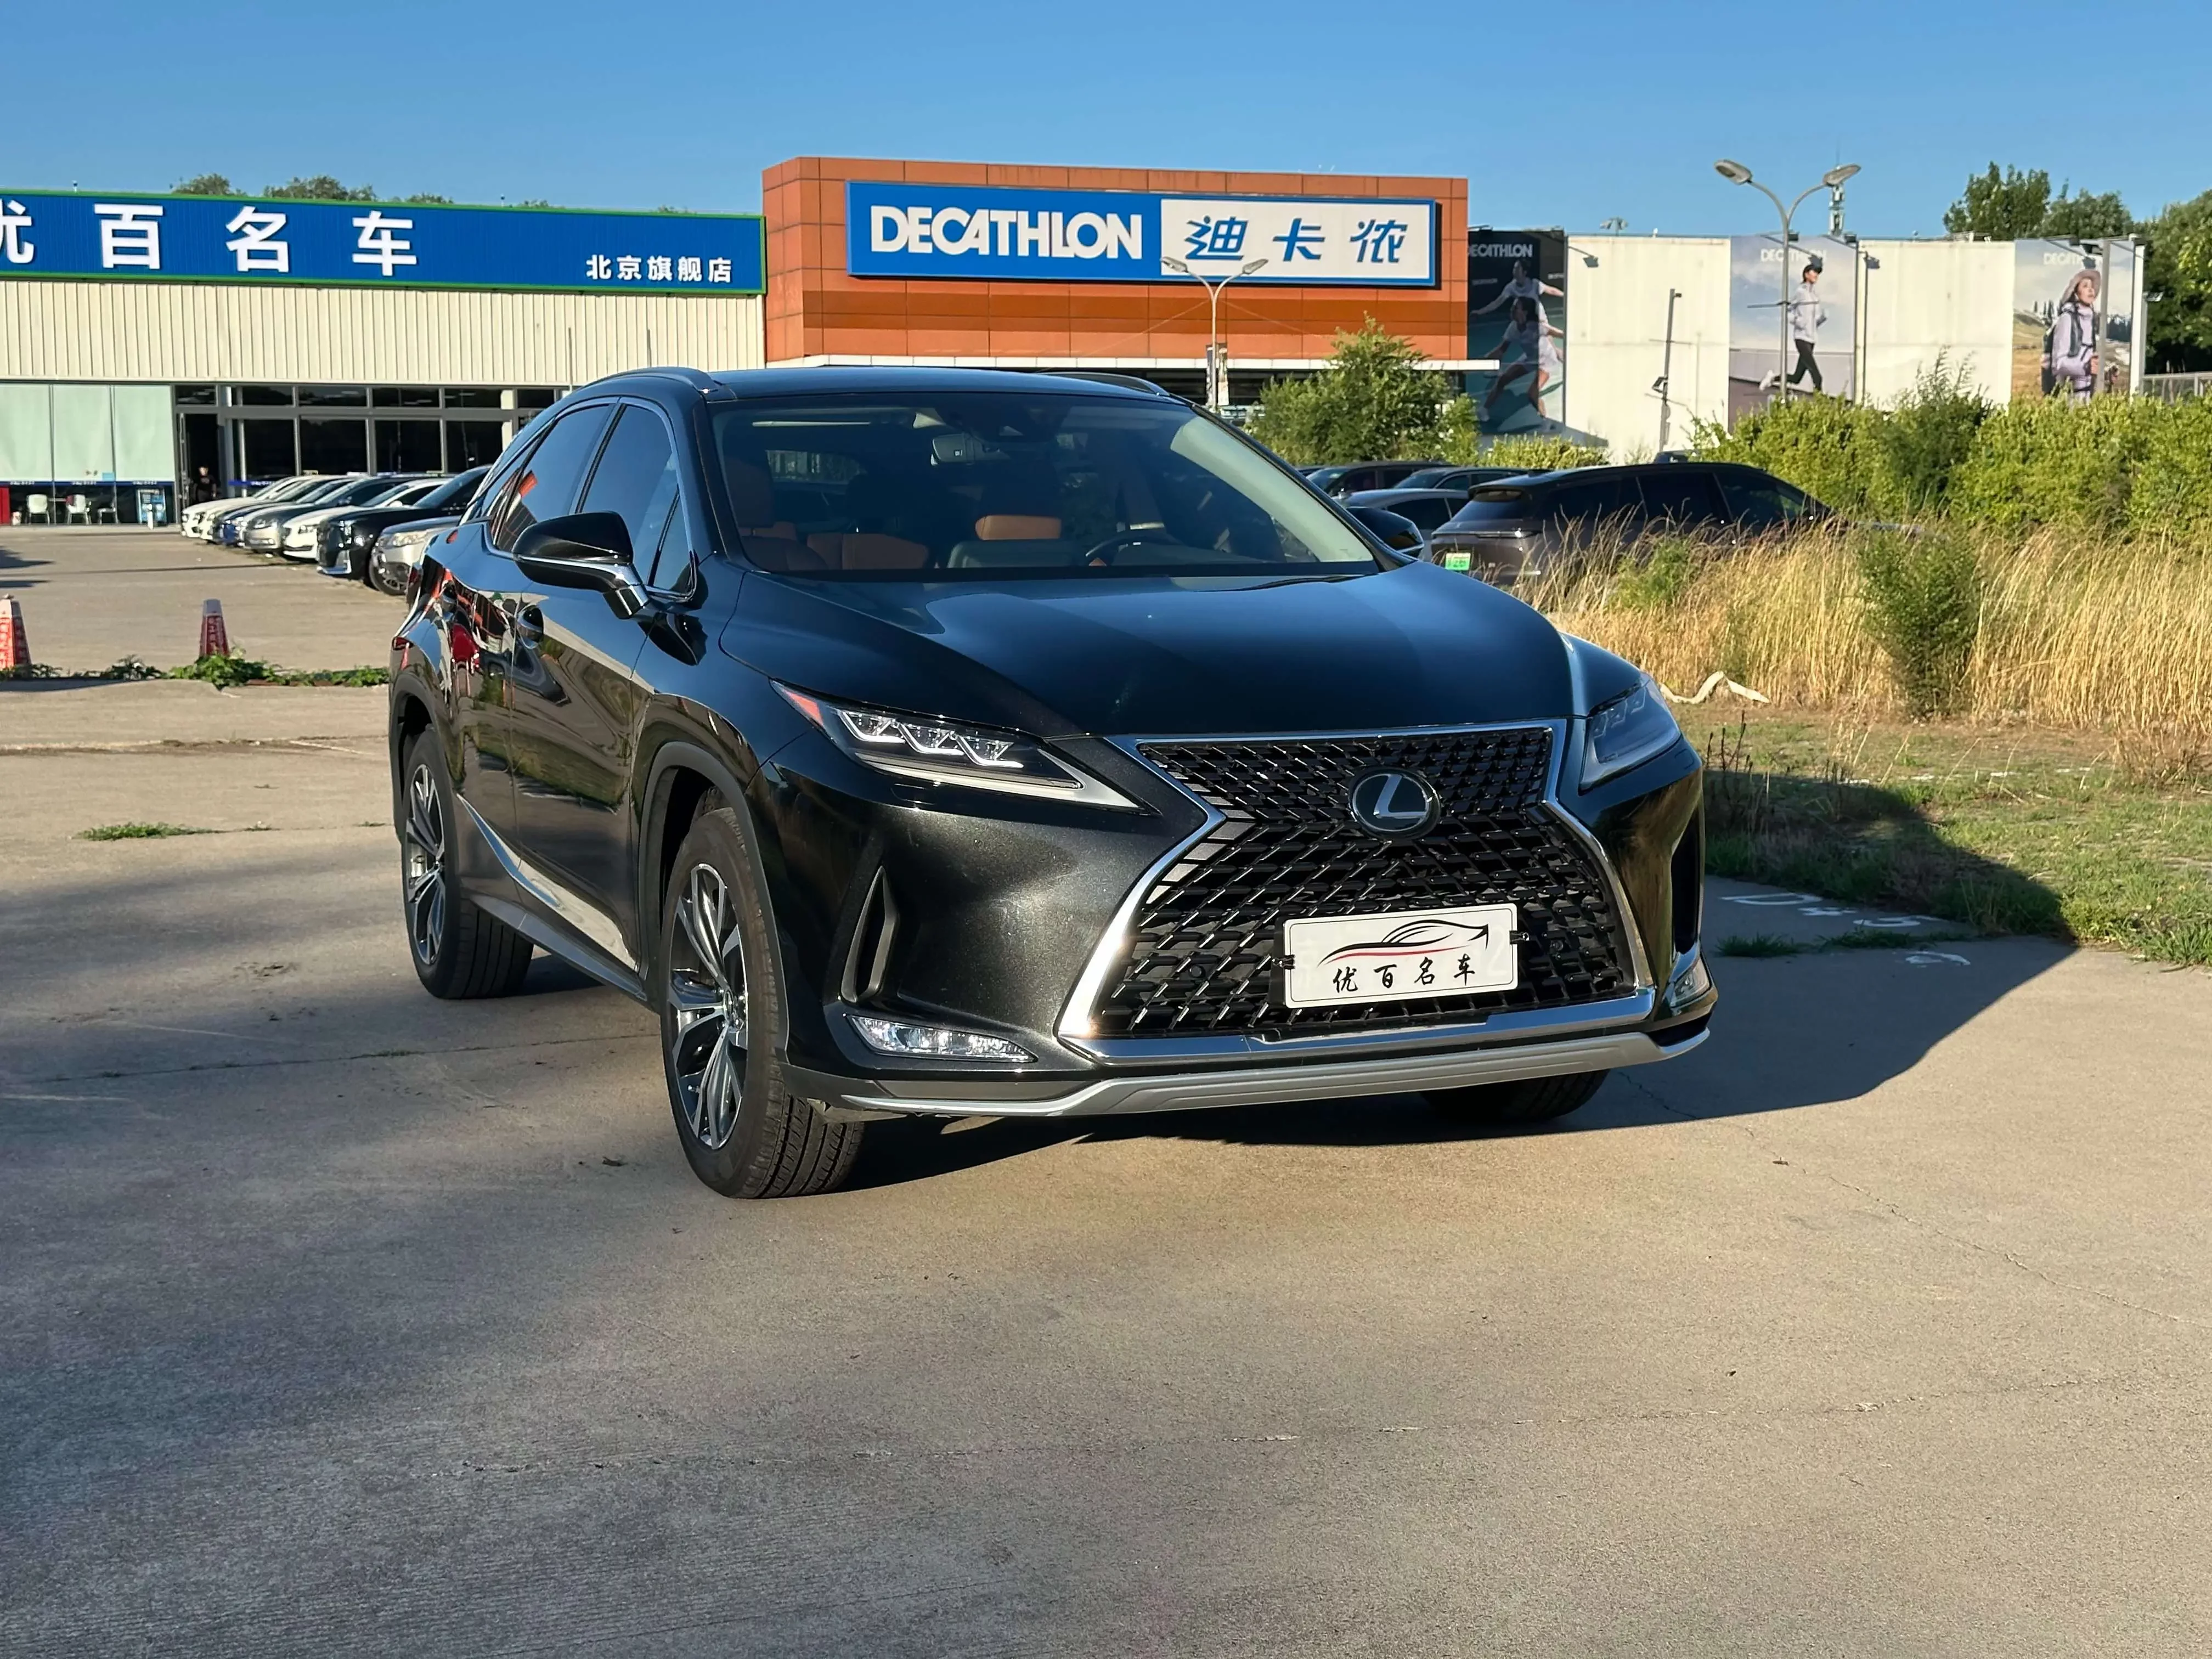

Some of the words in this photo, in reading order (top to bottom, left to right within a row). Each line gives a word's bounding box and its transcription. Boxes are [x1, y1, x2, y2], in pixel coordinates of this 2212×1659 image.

[870, 205, 1142, 259] DECATHLON
[1184, 216, 1408, 263] 迪卡侬
[1468, 244, 1533, 257] ECATHLON
[585, 254, 732, 283] 北京旗舰店
[1333, 953, 1475, 994] 优百名车
